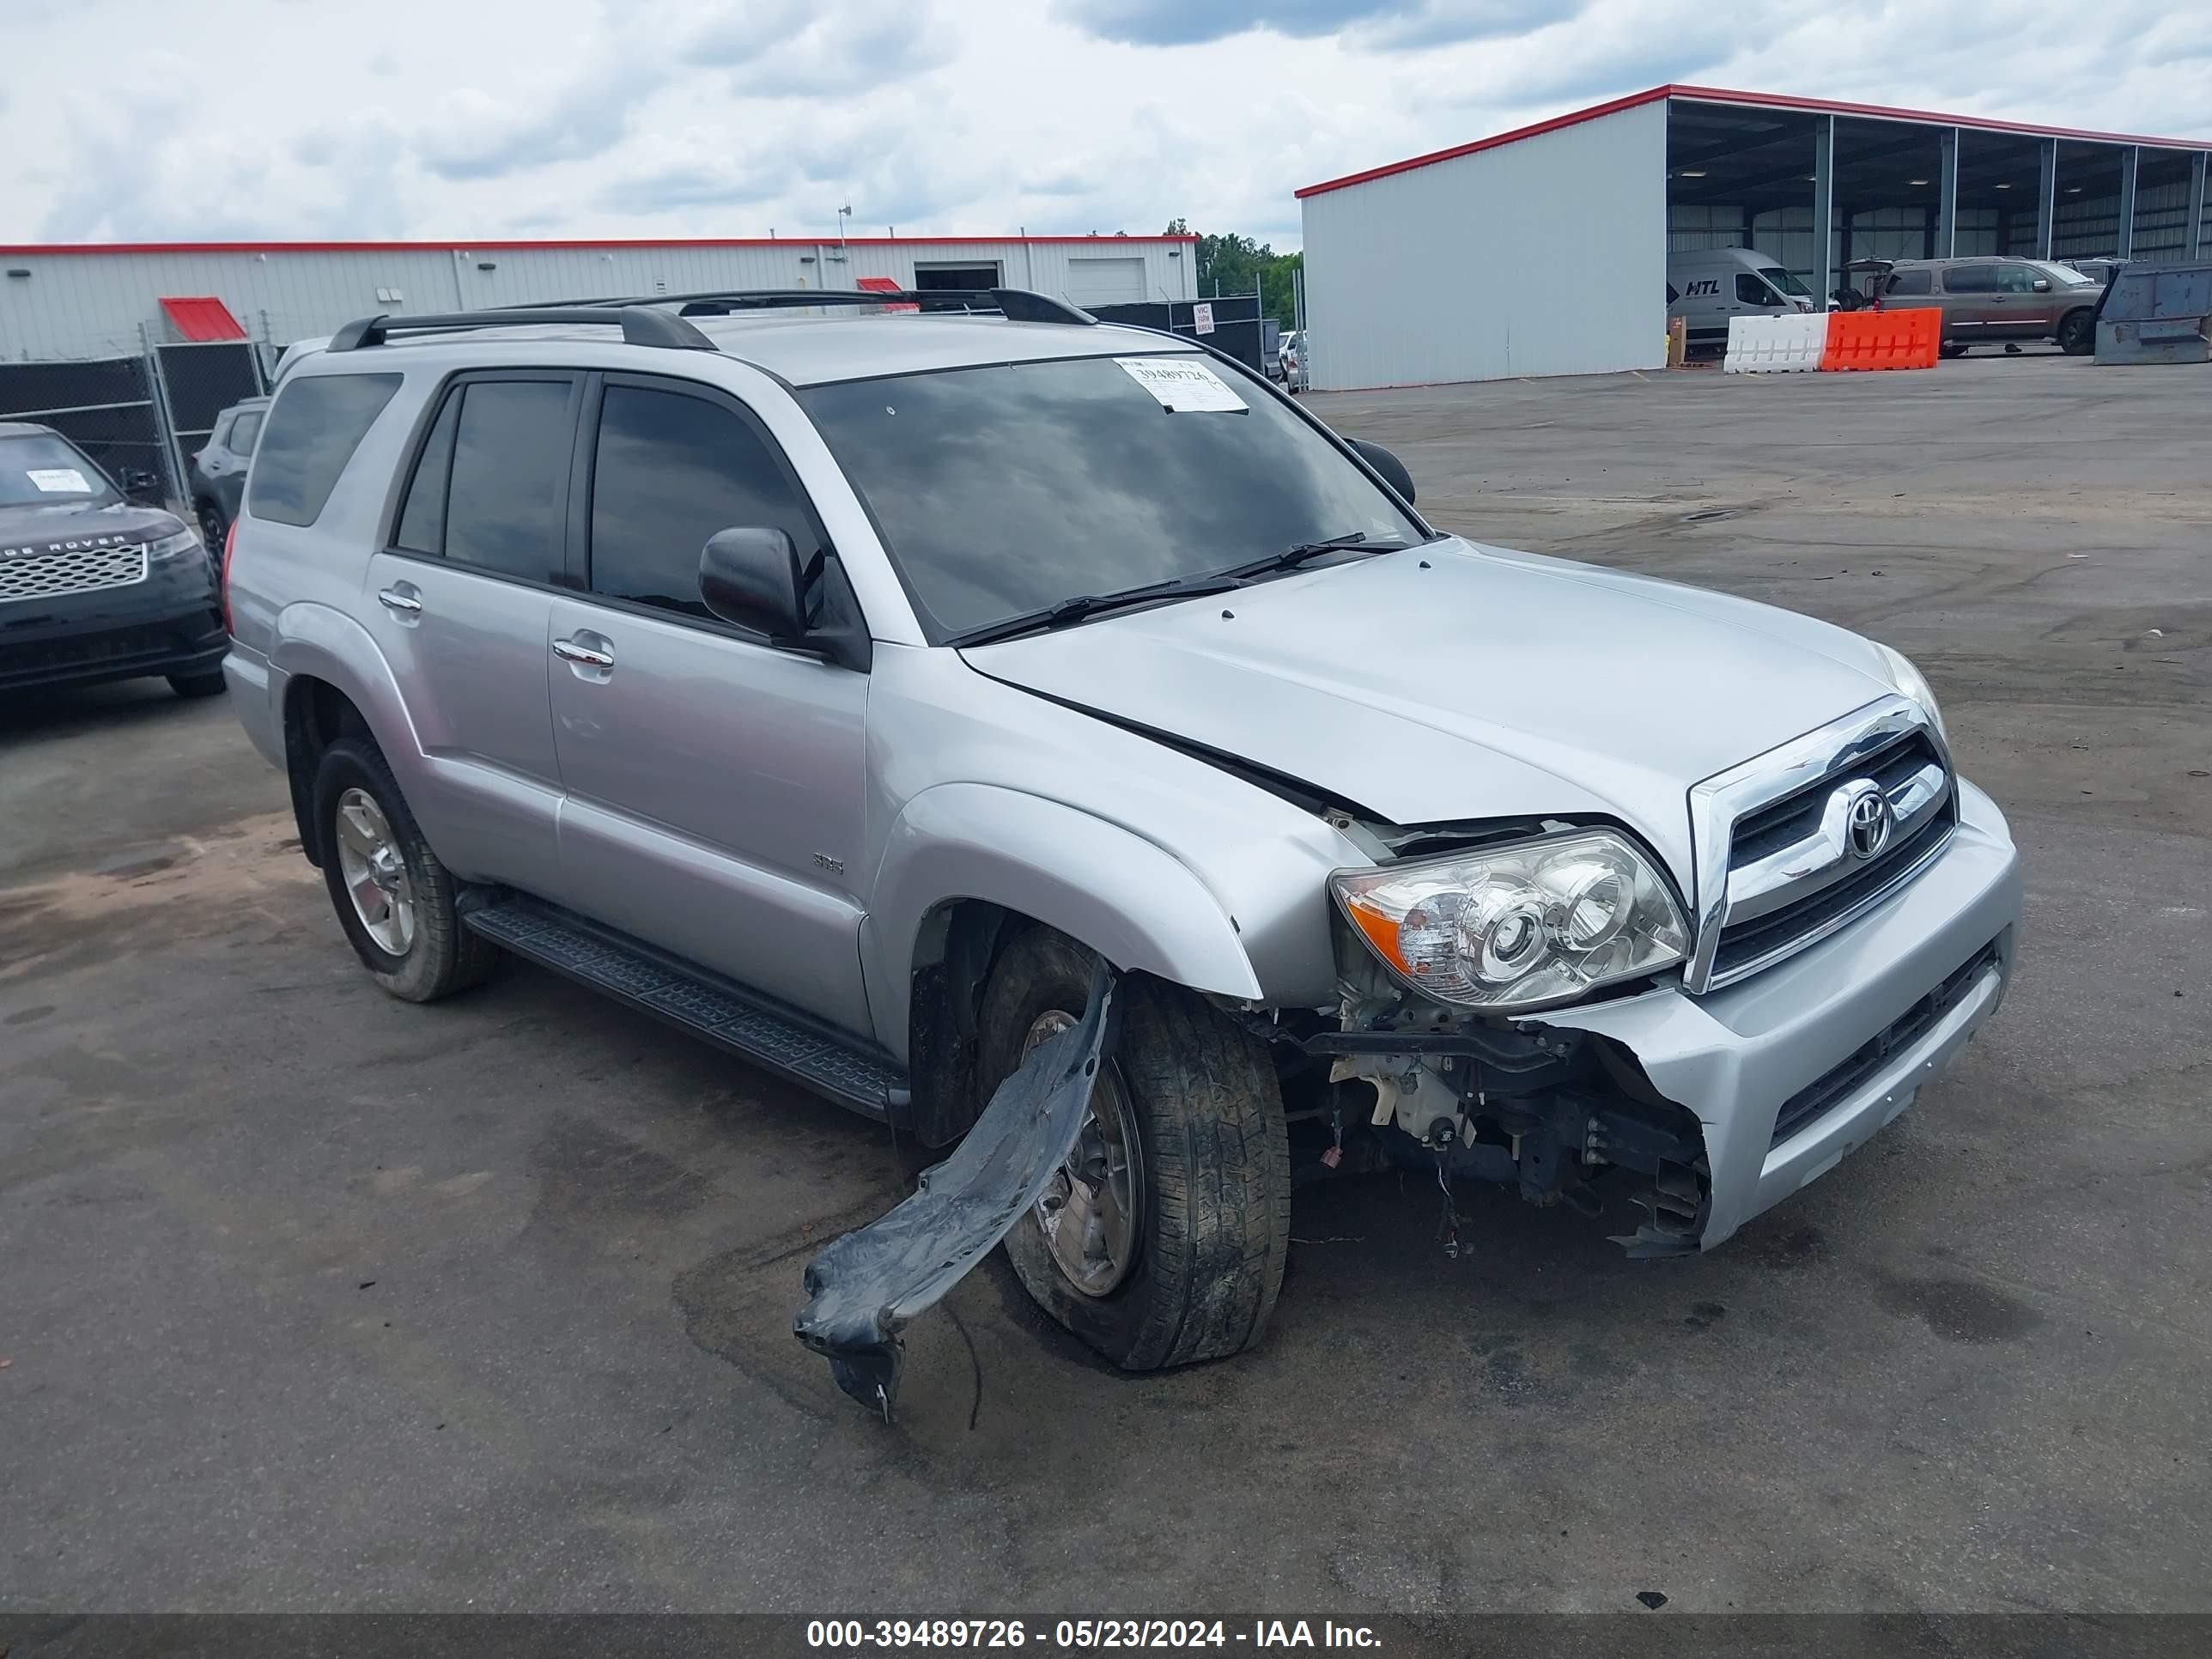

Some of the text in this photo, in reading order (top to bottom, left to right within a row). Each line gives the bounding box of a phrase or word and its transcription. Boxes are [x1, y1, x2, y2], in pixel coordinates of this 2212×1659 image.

[1197, 306, 1208, 314] VIC
[1135, 369, 1209, 381] 39489726
[48, 535, 125, 550] ROVER
